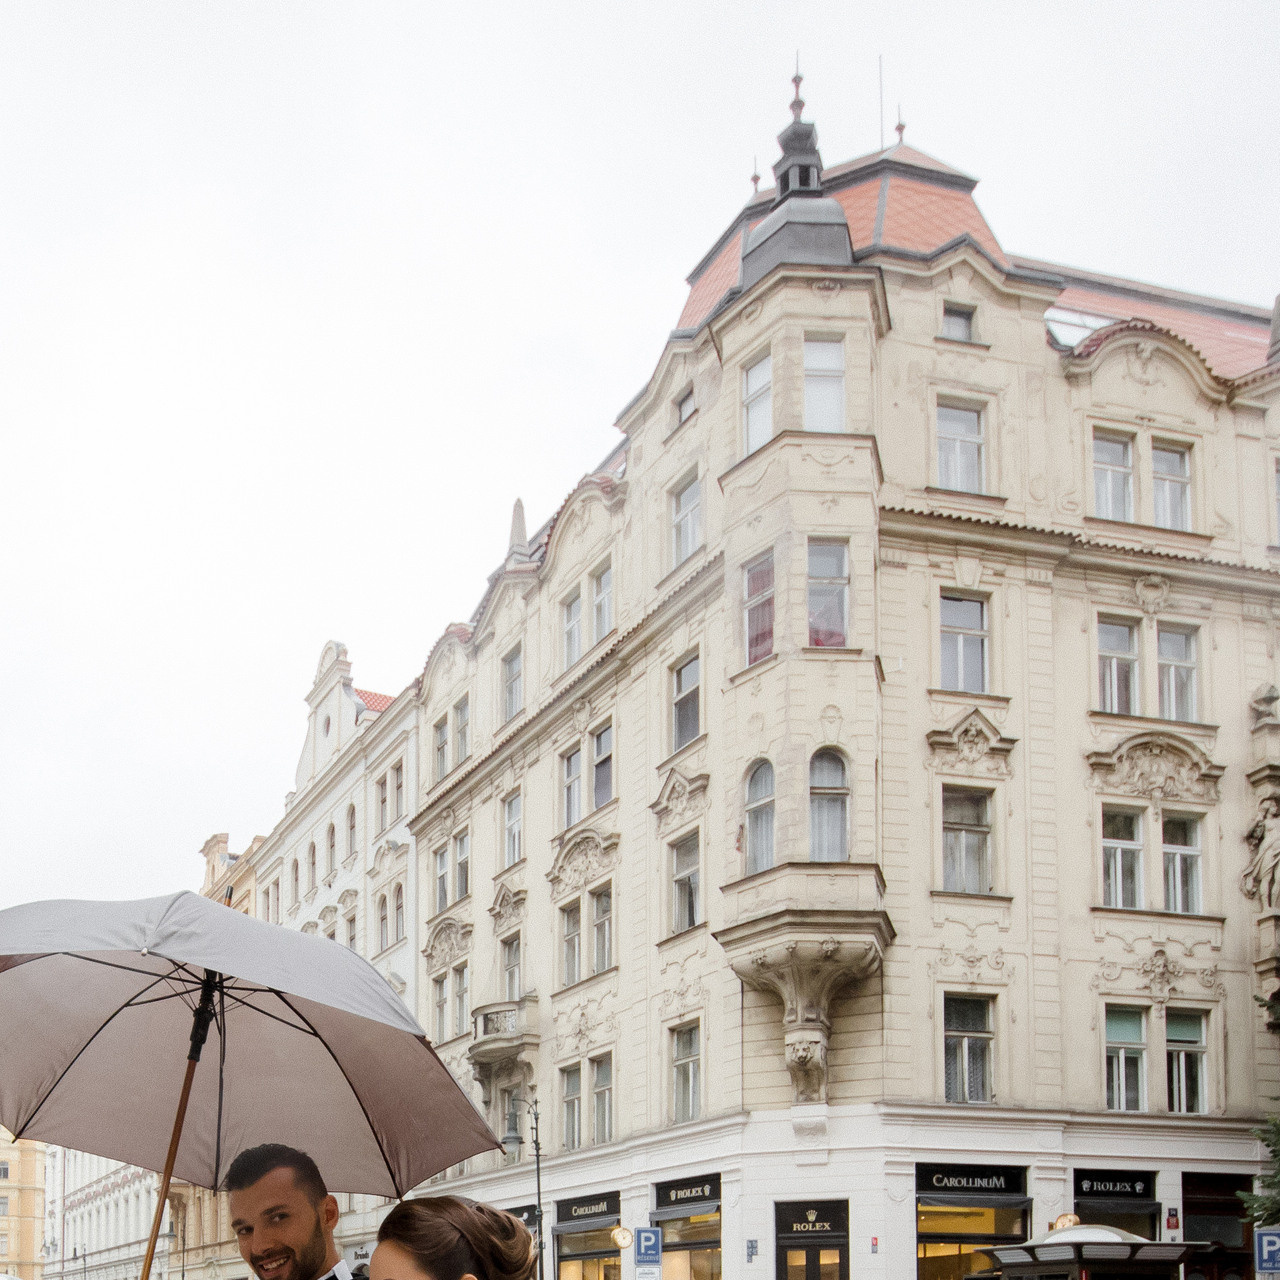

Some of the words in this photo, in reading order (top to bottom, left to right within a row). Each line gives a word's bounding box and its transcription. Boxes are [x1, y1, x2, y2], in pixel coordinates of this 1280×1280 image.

[933, 1174, 1005, 1189] CAROLLINUM
[1093, 1181, 1132, 1192] ROLEX
[677, 1188, 703, 1199] ROLEX
[792, 1222, 831, 1231] ROLEX
[640, 1232, 656, 1253] P
[1262, 1235, 1280, 1260] P
